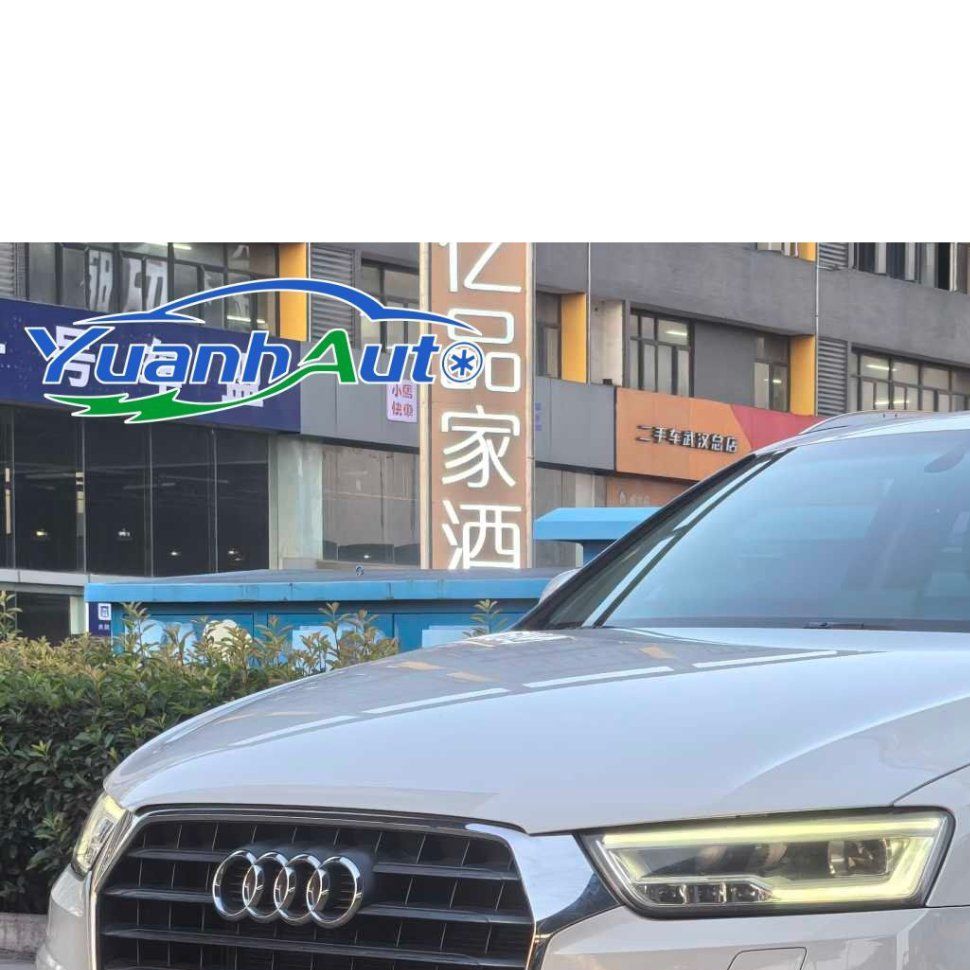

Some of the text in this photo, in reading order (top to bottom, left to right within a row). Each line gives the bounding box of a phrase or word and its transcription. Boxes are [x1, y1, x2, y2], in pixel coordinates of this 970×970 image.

[635, 424, 739, 453] 二手车武汉总店
